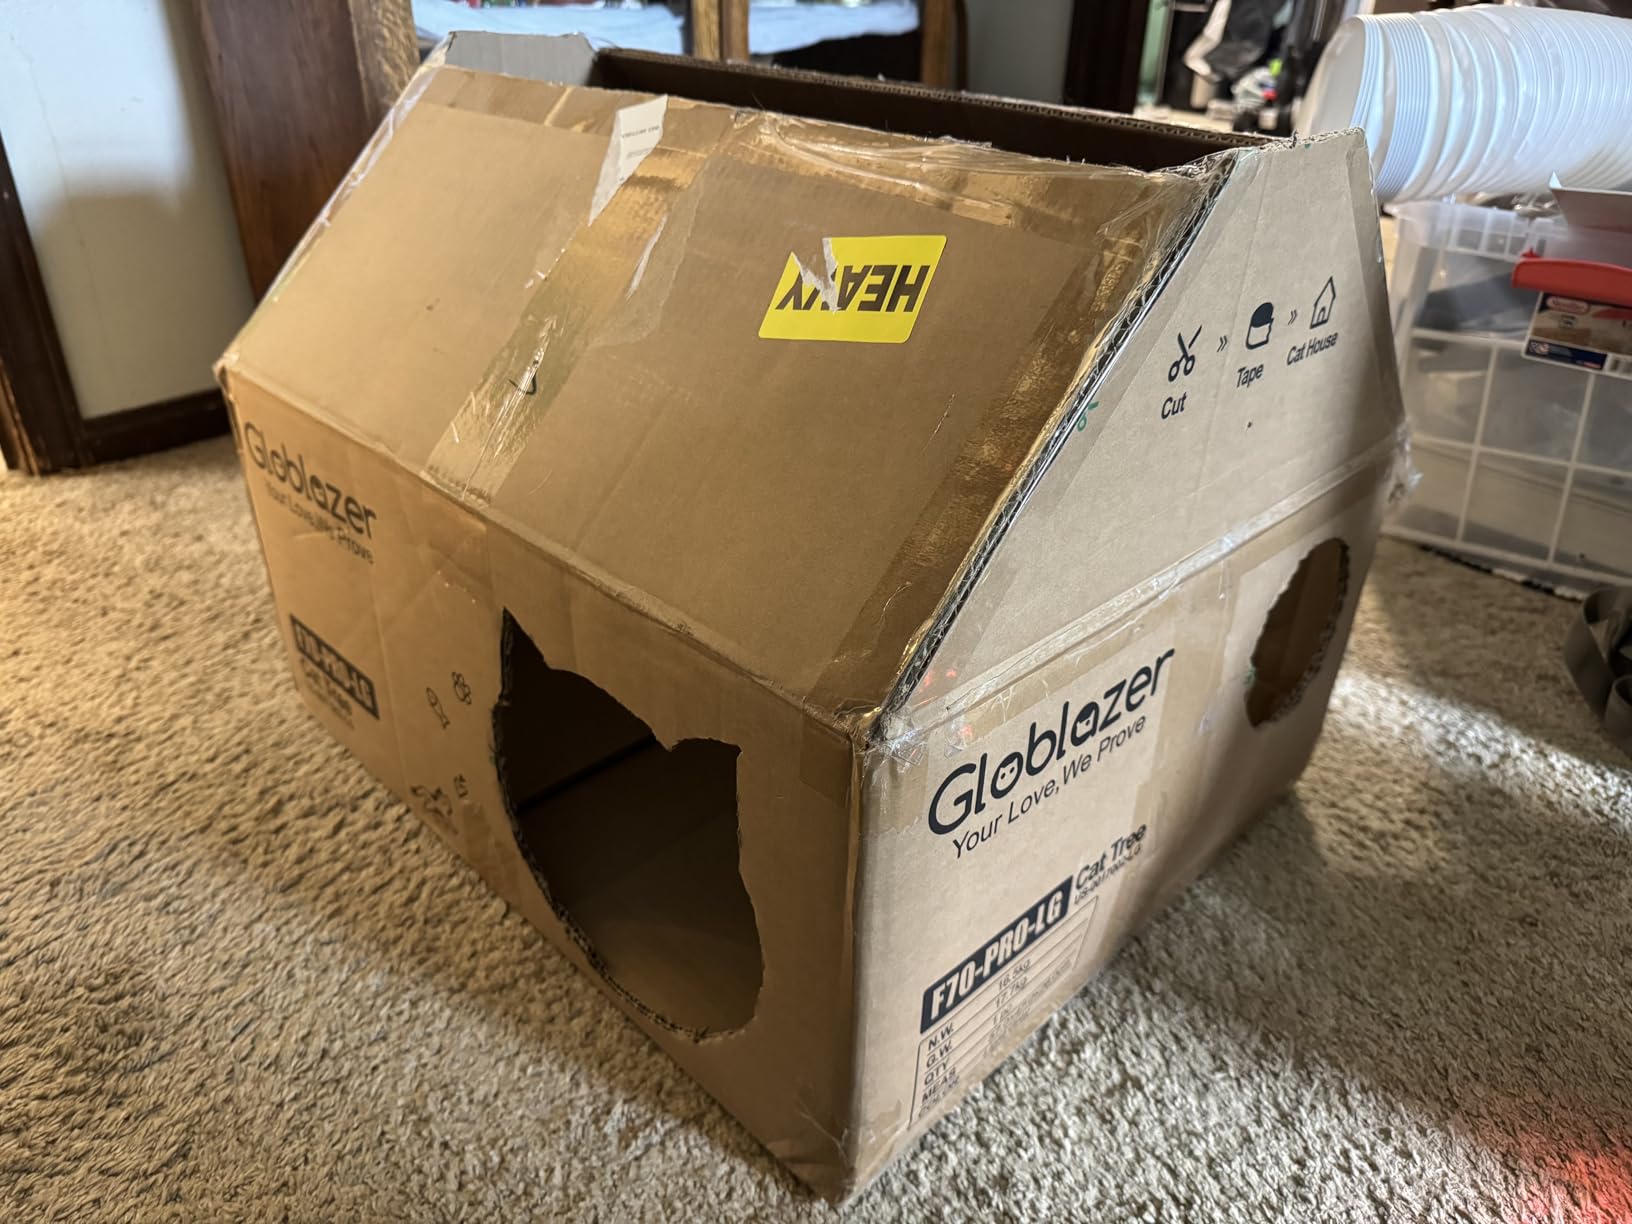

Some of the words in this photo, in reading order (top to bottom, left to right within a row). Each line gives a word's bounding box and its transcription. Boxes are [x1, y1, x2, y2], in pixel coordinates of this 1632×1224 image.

[1286, 341, 1305, 366] Cat
[1304, 332, 1339, 360] House
[1236, 364, 1264, 388] Tape
[1161, 392, 1187, 420] Cut
[928, 648, 1175, 835] Globlazer
[952, 814, 1002, 859] Your
[1097, 715, 1146, 763] Prove
[1075, 850, 1107, 890] Cat
[1110, 824, 1147, 861] Tree
[930, 889, 1065, 1021] F70-PRO-LG
[928, 1022, 954, 1051] N.W.
[924, 1056, 950, 1086] QTY
